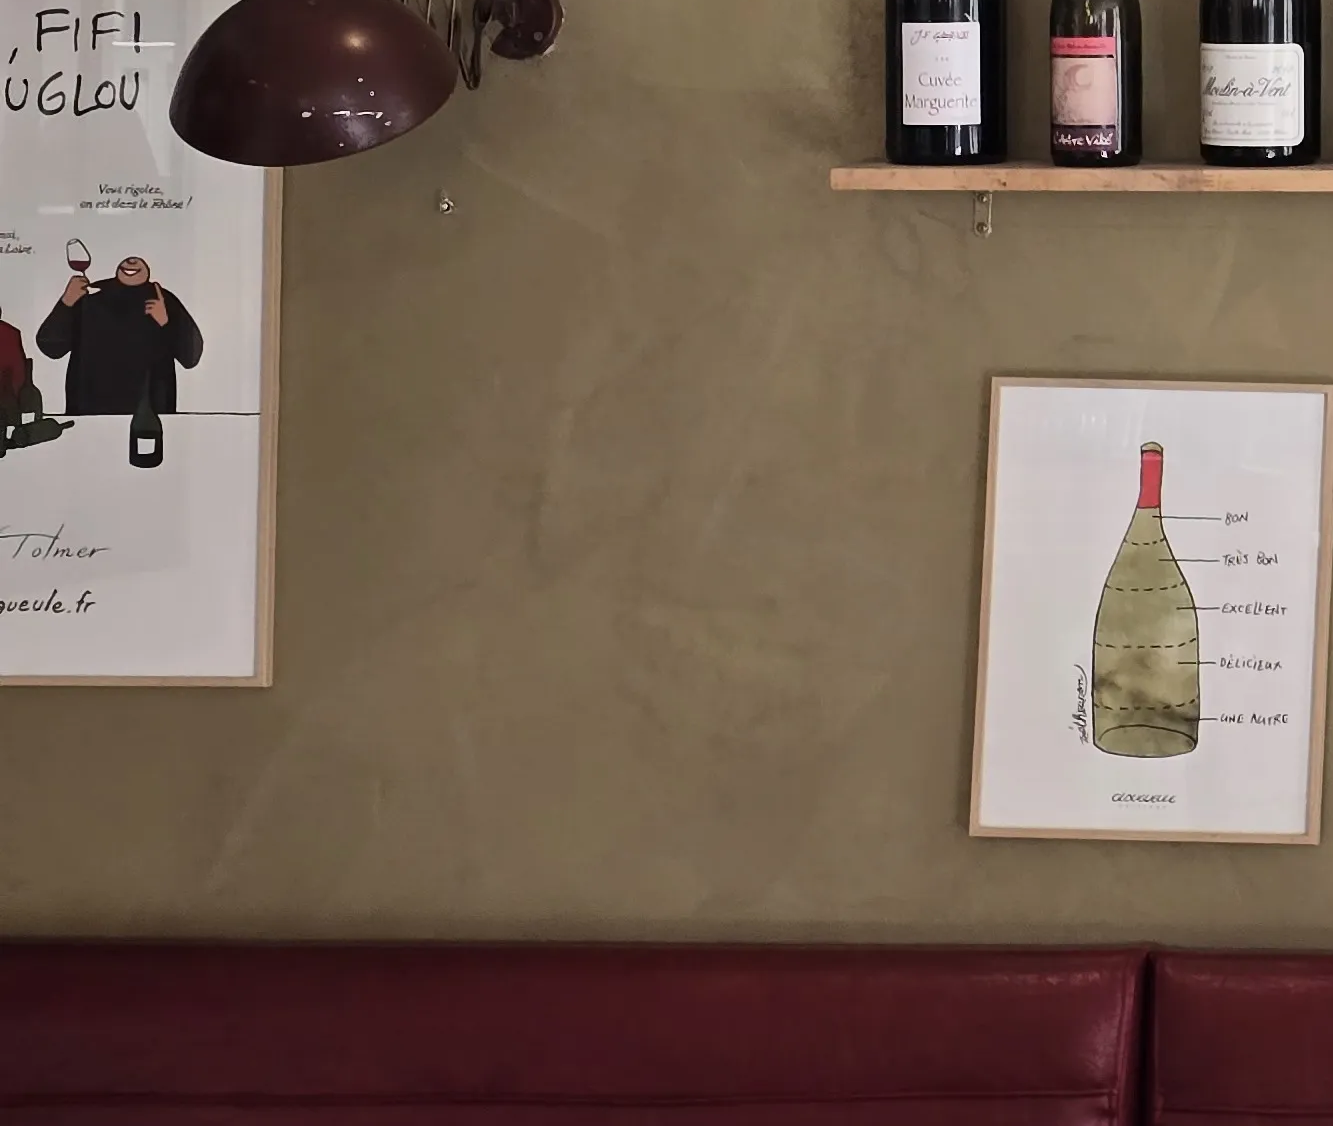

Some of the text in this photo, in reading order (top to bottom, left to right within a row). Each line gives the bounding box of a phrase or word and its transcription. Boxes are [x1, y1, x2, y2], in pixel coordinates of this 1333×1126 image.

[918, 71, 962, 87] Cuvée
[904, 92, 977, 116] Marguerite
[98, 183, 122, 195] Vous
[79, 200, 93, 210] on
[95, 199, 111, 210] est
[138, 199, 148, 210] le
[1221, 602, 1288, 616] EXCELLENT
